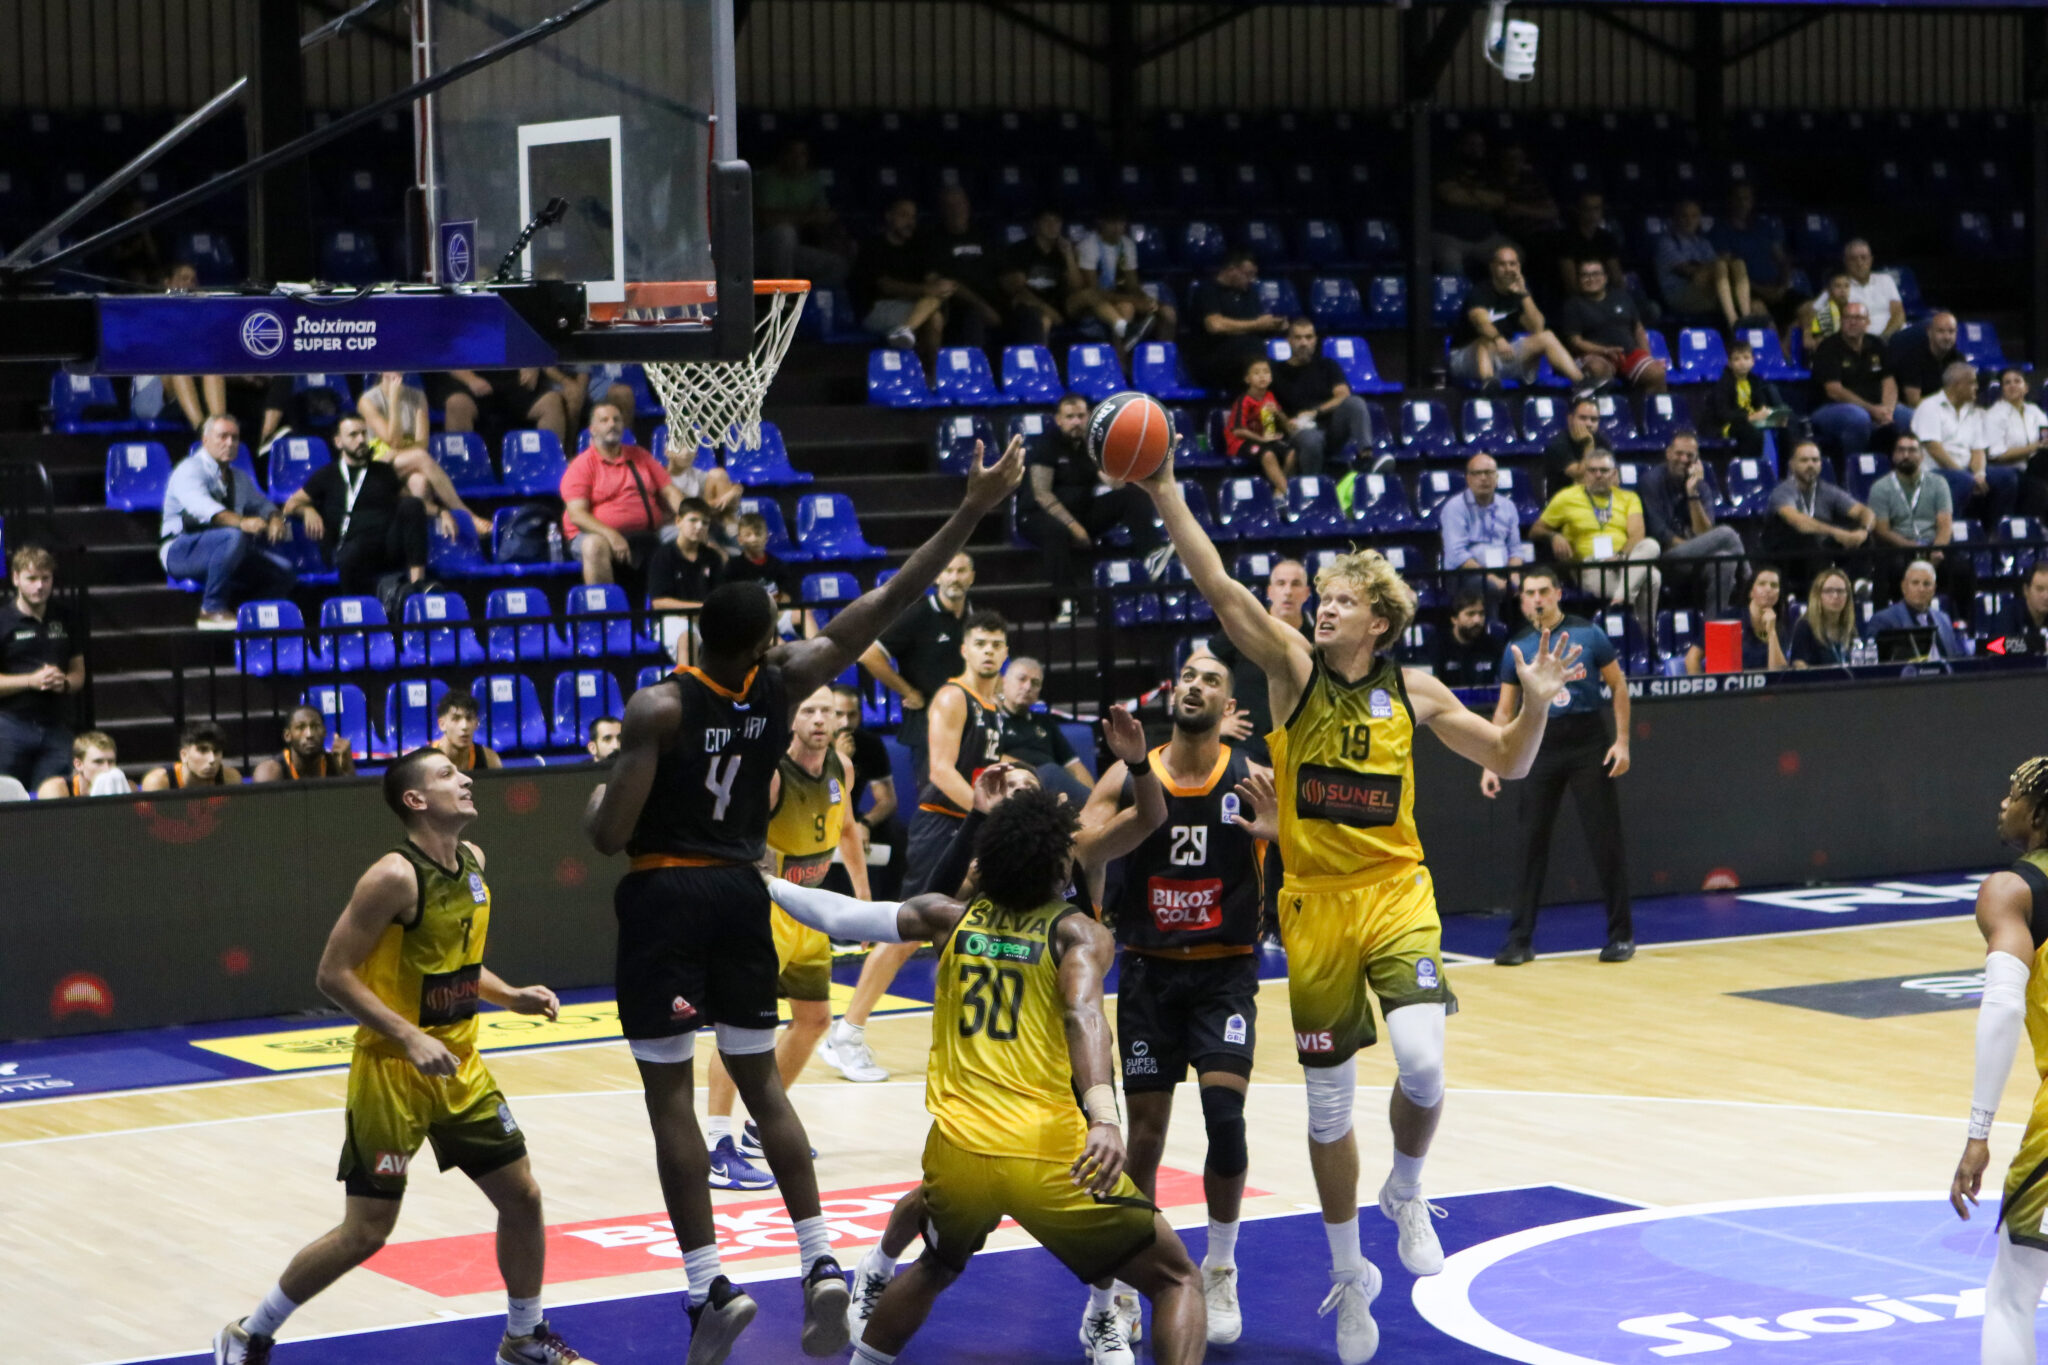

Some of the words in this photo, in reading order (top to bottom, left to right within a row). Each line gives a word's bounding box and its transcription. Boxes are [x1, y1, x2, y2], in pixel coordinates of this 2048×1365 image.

[293, 315, 377, 334] Stoiximan
[293, 338, 342, 351] SUPER
[346, 337, 377, 351] CUP
[1651, 677, 1717, 696] SUPER
[1724, 674, 1767, 692] CUP
[1340, 724, 1371, 761] 19
[705, 754, 742, 821] 4
[1326, 783, 1394, 808] SUNEL
[814, 814, 826, 843] 9
[1170, 825, 1208, 866] 29
[966, 906, 1048, 936] SILVA
[1156, 907, 1212, 924] COLA
[461, 917, 473, 954] 7
[988, 942, 1031, 957] green
[959, 963, 1024, 1041] 30
[1126, 1057, 1156, 1067] SUPER
[1126, 1065, 1158, 1076] CARGO
